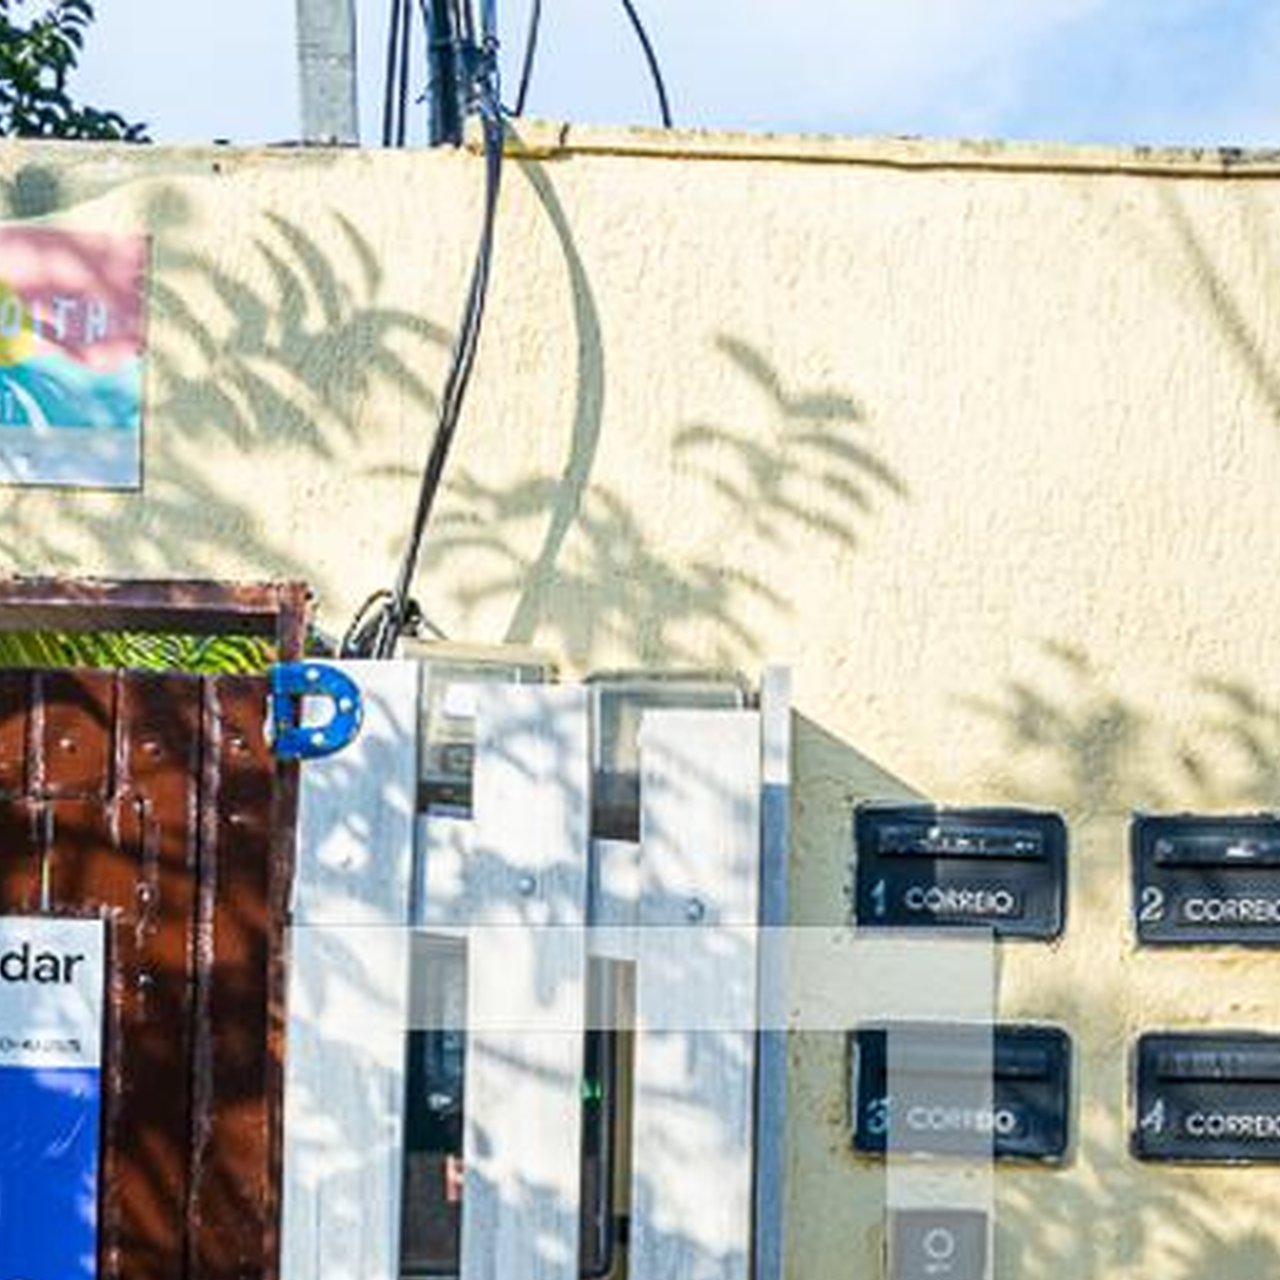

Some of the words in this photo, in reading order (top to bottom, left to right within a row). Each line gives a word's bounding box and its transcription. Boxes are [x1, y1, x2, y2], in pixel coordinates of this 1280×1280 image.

[871, 879, 886, 917] 1
[906, 886, 1015, 913] CORREIO
[1139, 886, 1164, 921] 2
[867, 1098, 892, 1134] 3
[1141, 1099, 1165, 1133] 4
